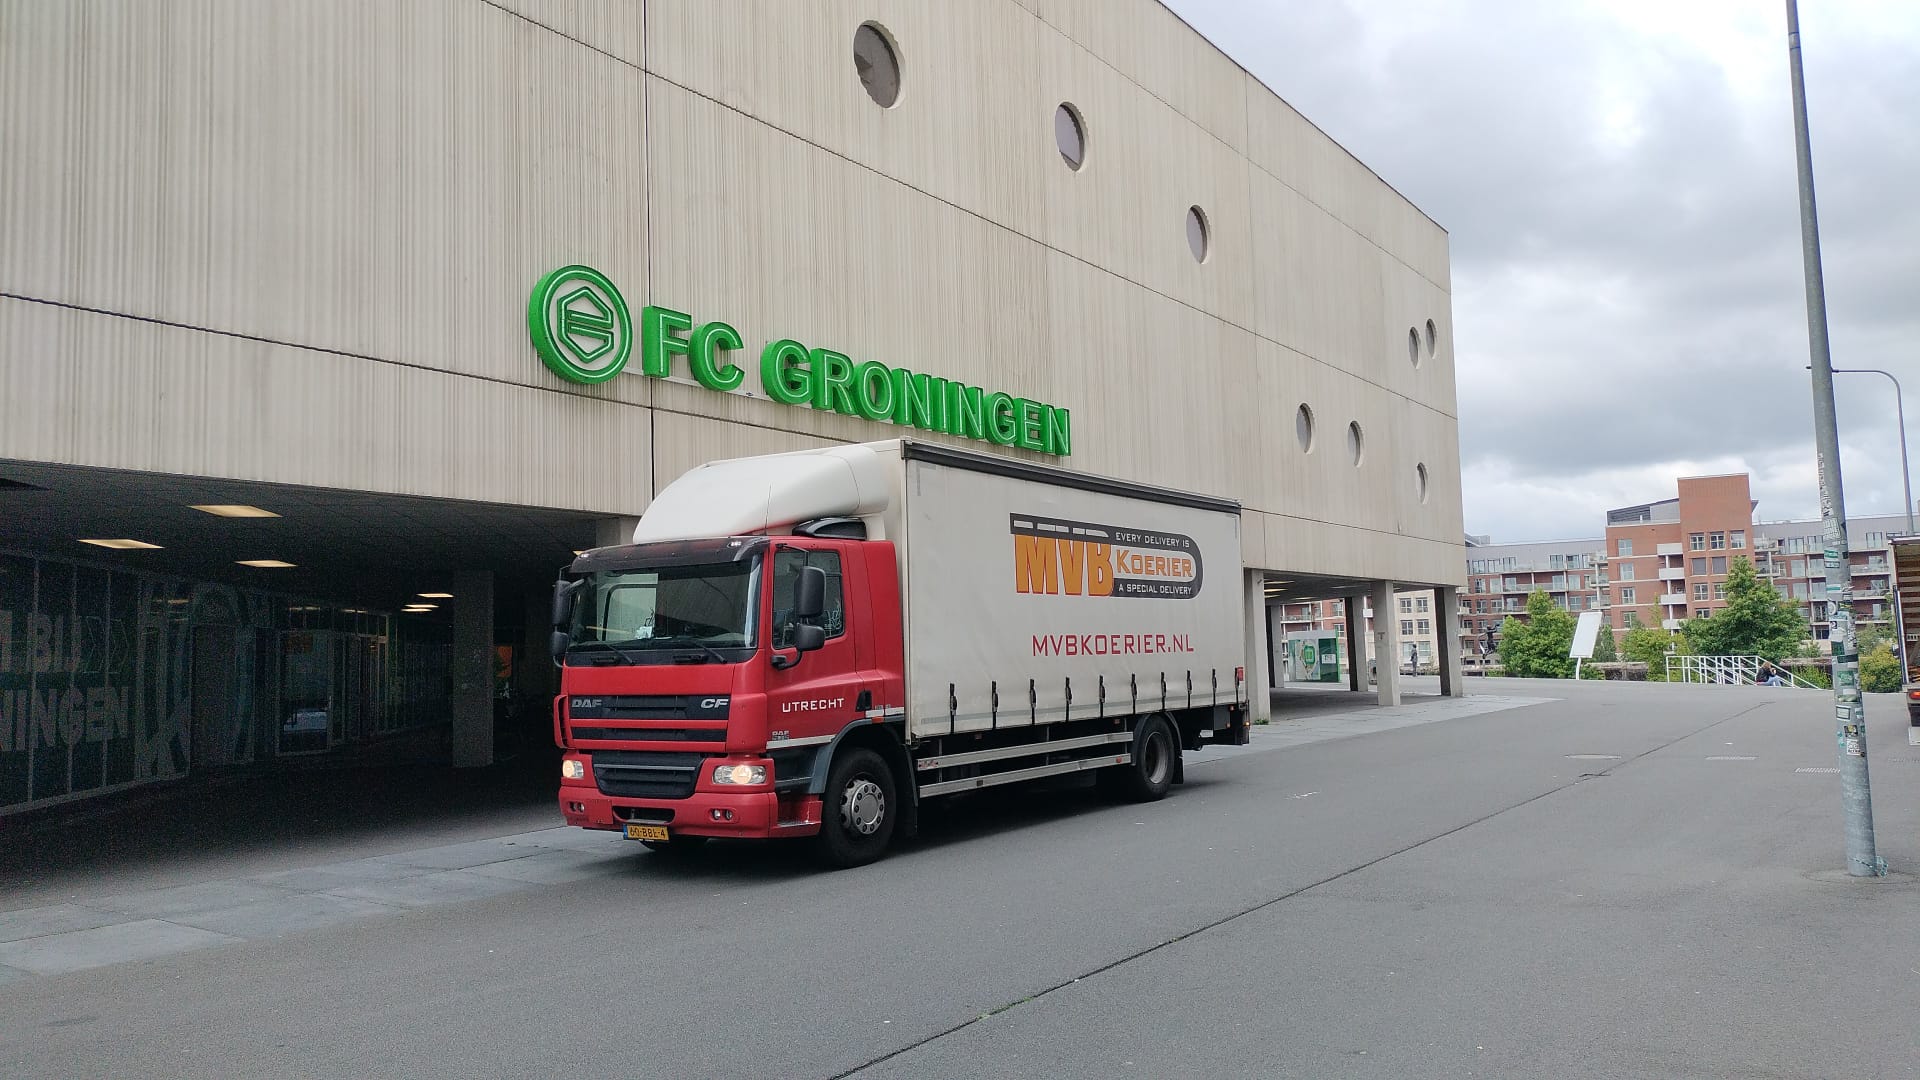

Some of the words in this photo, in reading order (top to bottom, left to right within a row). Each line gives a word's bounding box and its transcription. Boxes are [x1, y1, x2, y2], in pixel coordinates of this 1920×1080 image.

[642, 305, 745, 392] FC
[760, 338, 1073, 457] GRONINGEN
[1115, 531, 1142, 543] EVERY
[1144, 535, 1180, 548] DELIVERY
[1182, 539, 1190, 548] IS
[1014, 533, 1115, 598] MVB
[1116, 549, 1193, 578] KOERIER
[1118, 583, 1124, 592] A
[1126, 583, 1158, 594] SPECIAL
[1160, 585, 1192, 595] DELIVERY
[1032, 633, 1194, 657] MVBKOERIER.NL
[571, 699, 602, 709] DAF
[700, 698, 729, 709] CF
[782, 697, 845, 713] UTRECHT
